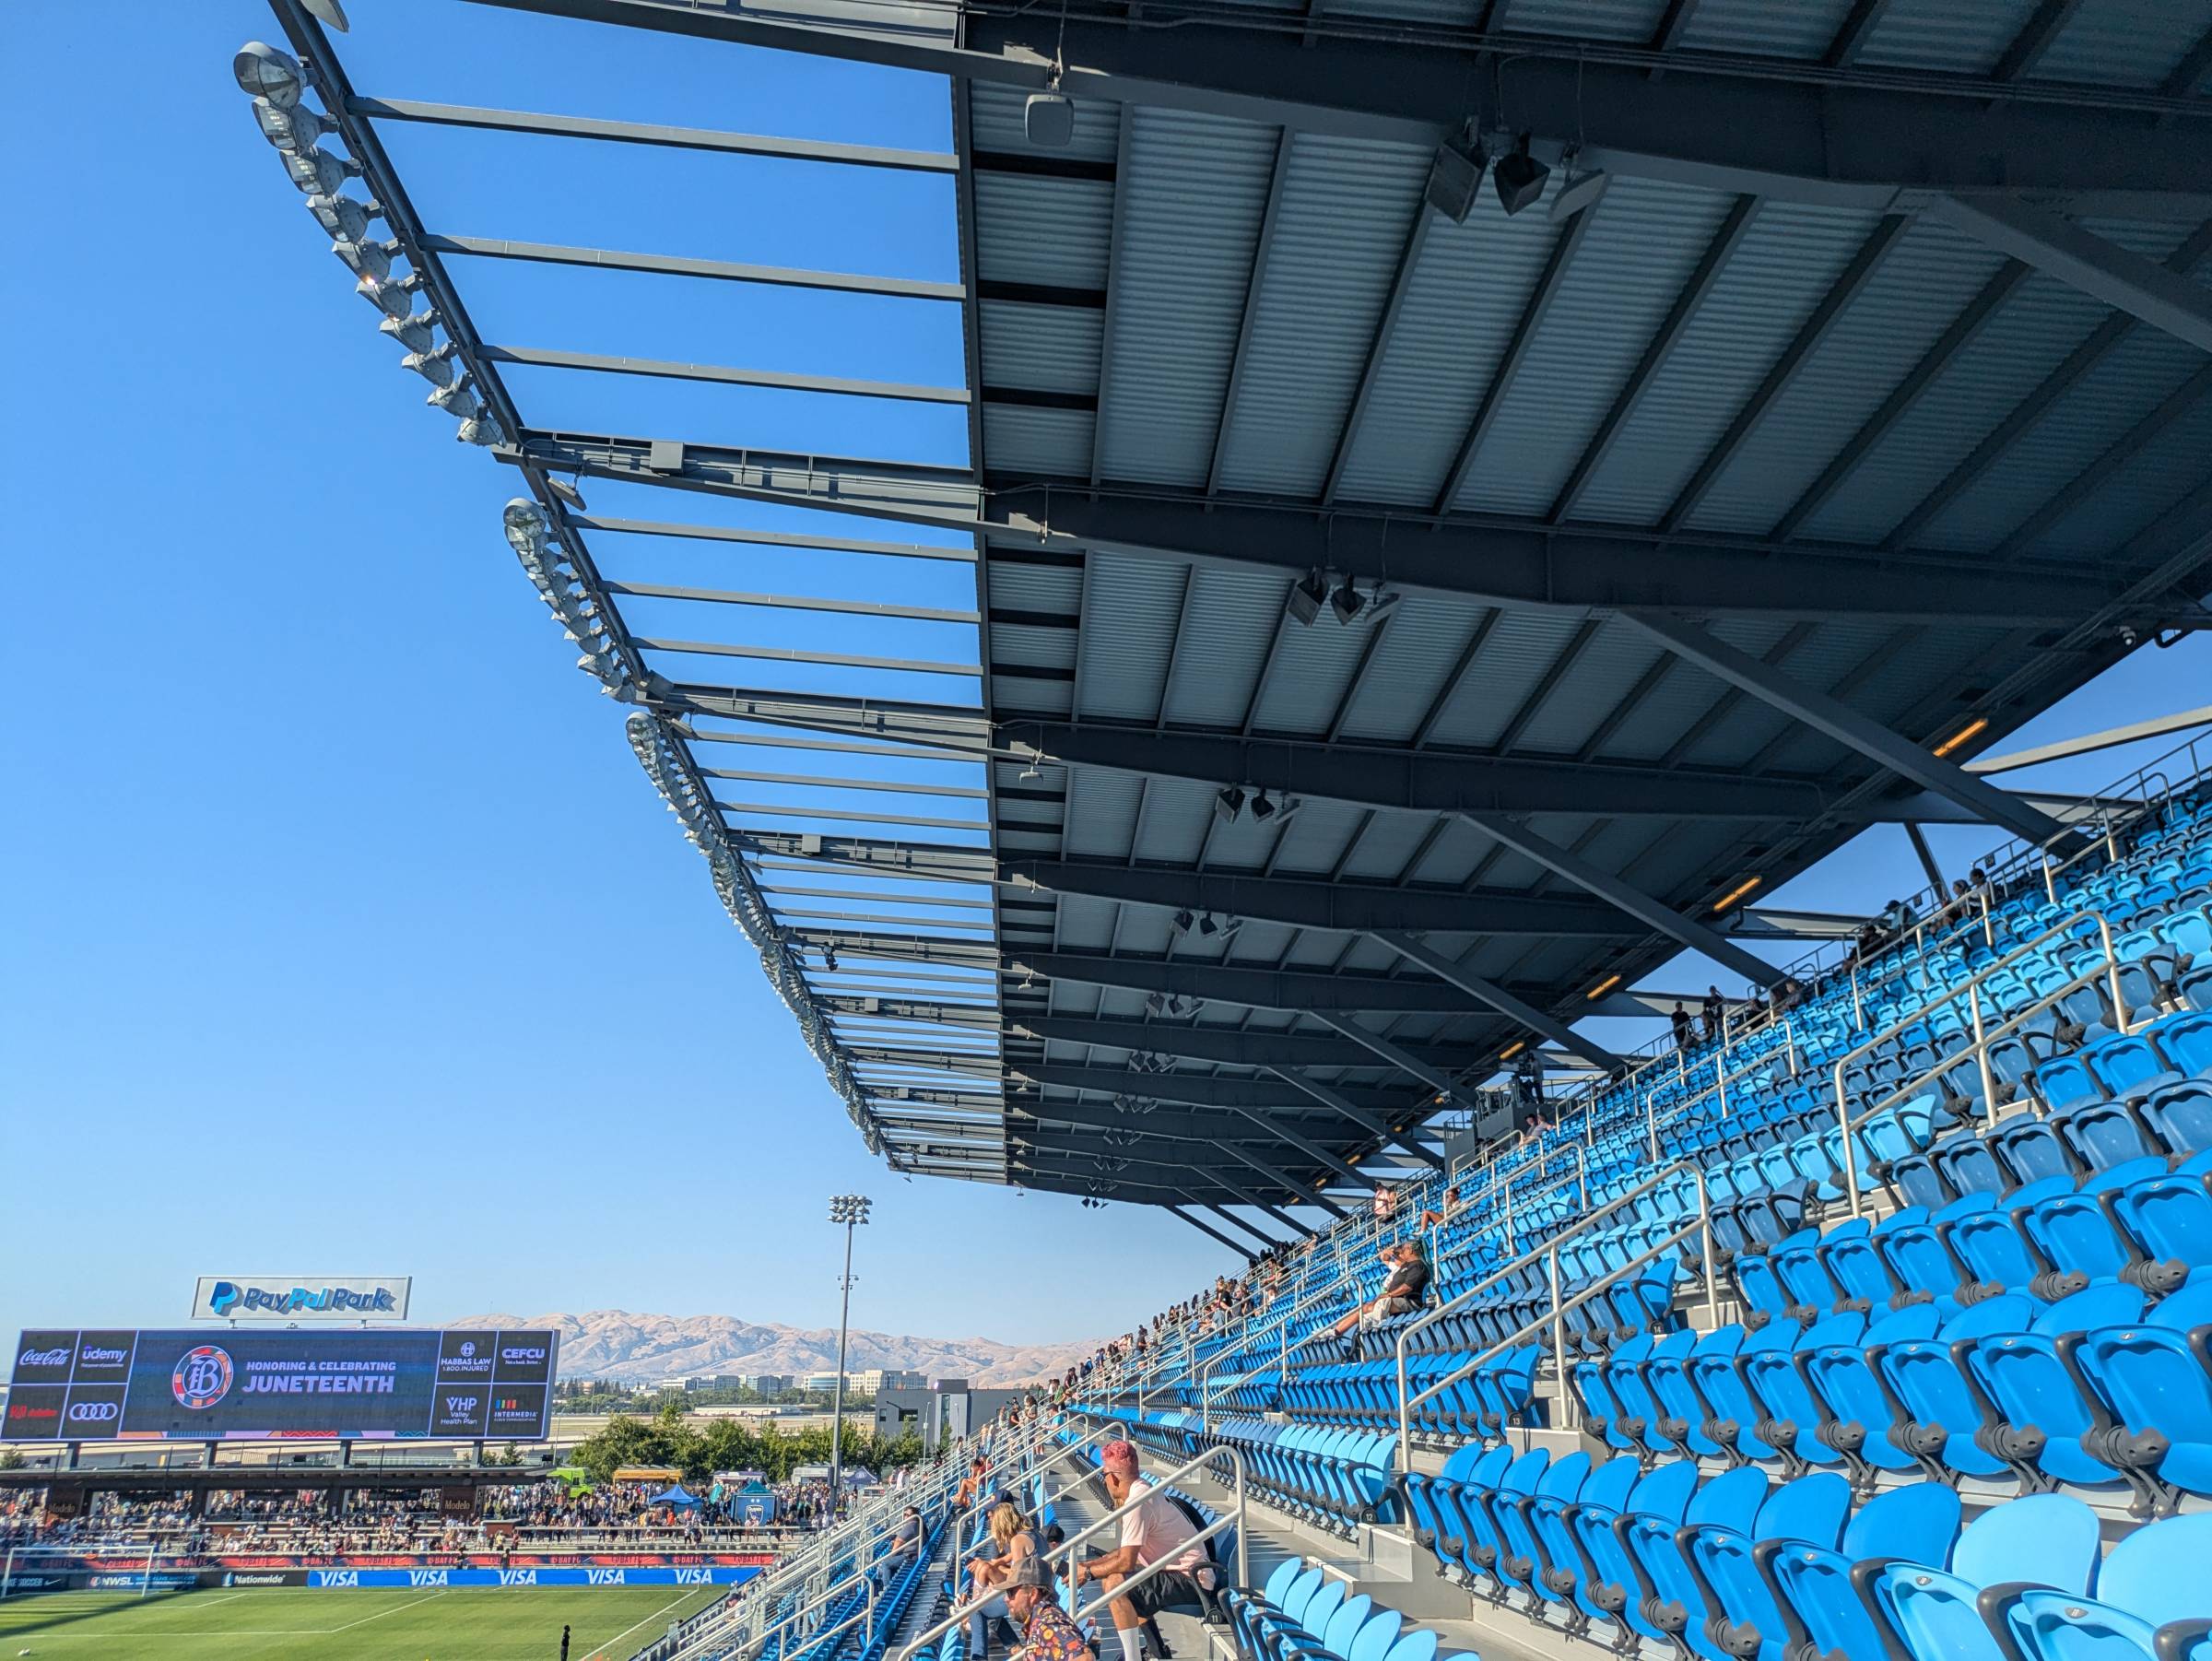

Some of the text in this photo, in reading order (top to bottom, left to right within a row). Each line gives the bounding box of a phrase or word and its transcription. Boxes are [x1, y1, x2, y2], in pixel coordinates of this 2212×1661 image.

[243, 1287, 396, 1313] PayPal Park
[1653, 1325, 1661, 1334] 14
[82, 1345, 128, 1362] udemy
[501, 1348, 546, 1360] CEFCU
[245, 1361, 396, 1372] HONORING & CELEBRATING
[441, 1358, 491, 1366] HABBAS LAW
[241, 1375, 395, 1394] JUNETEENTH
[446, 1396, 477, 1411] VHP
[451, 1410, 470, 1420] Valley
[494, 1410, 536, 1419] INTERMEDIA
[1512, 1417, 1521, 1425] 13
[444, 1499, 471, 1510] Modelo
[1366, 1513, 1373, 1522] 12
[102, 1577, 135, 1586] NWSL
[318, 1571, 359, 1586] VISA
[407, 1570, 449, 1585] VISA
[497, 1570, 537, 1585] VISA
[585, 1569, 626, 1584] VISA
[673, 1569, 713, 1584] VISA
[1211, 1615, 1218, 1623] 11
